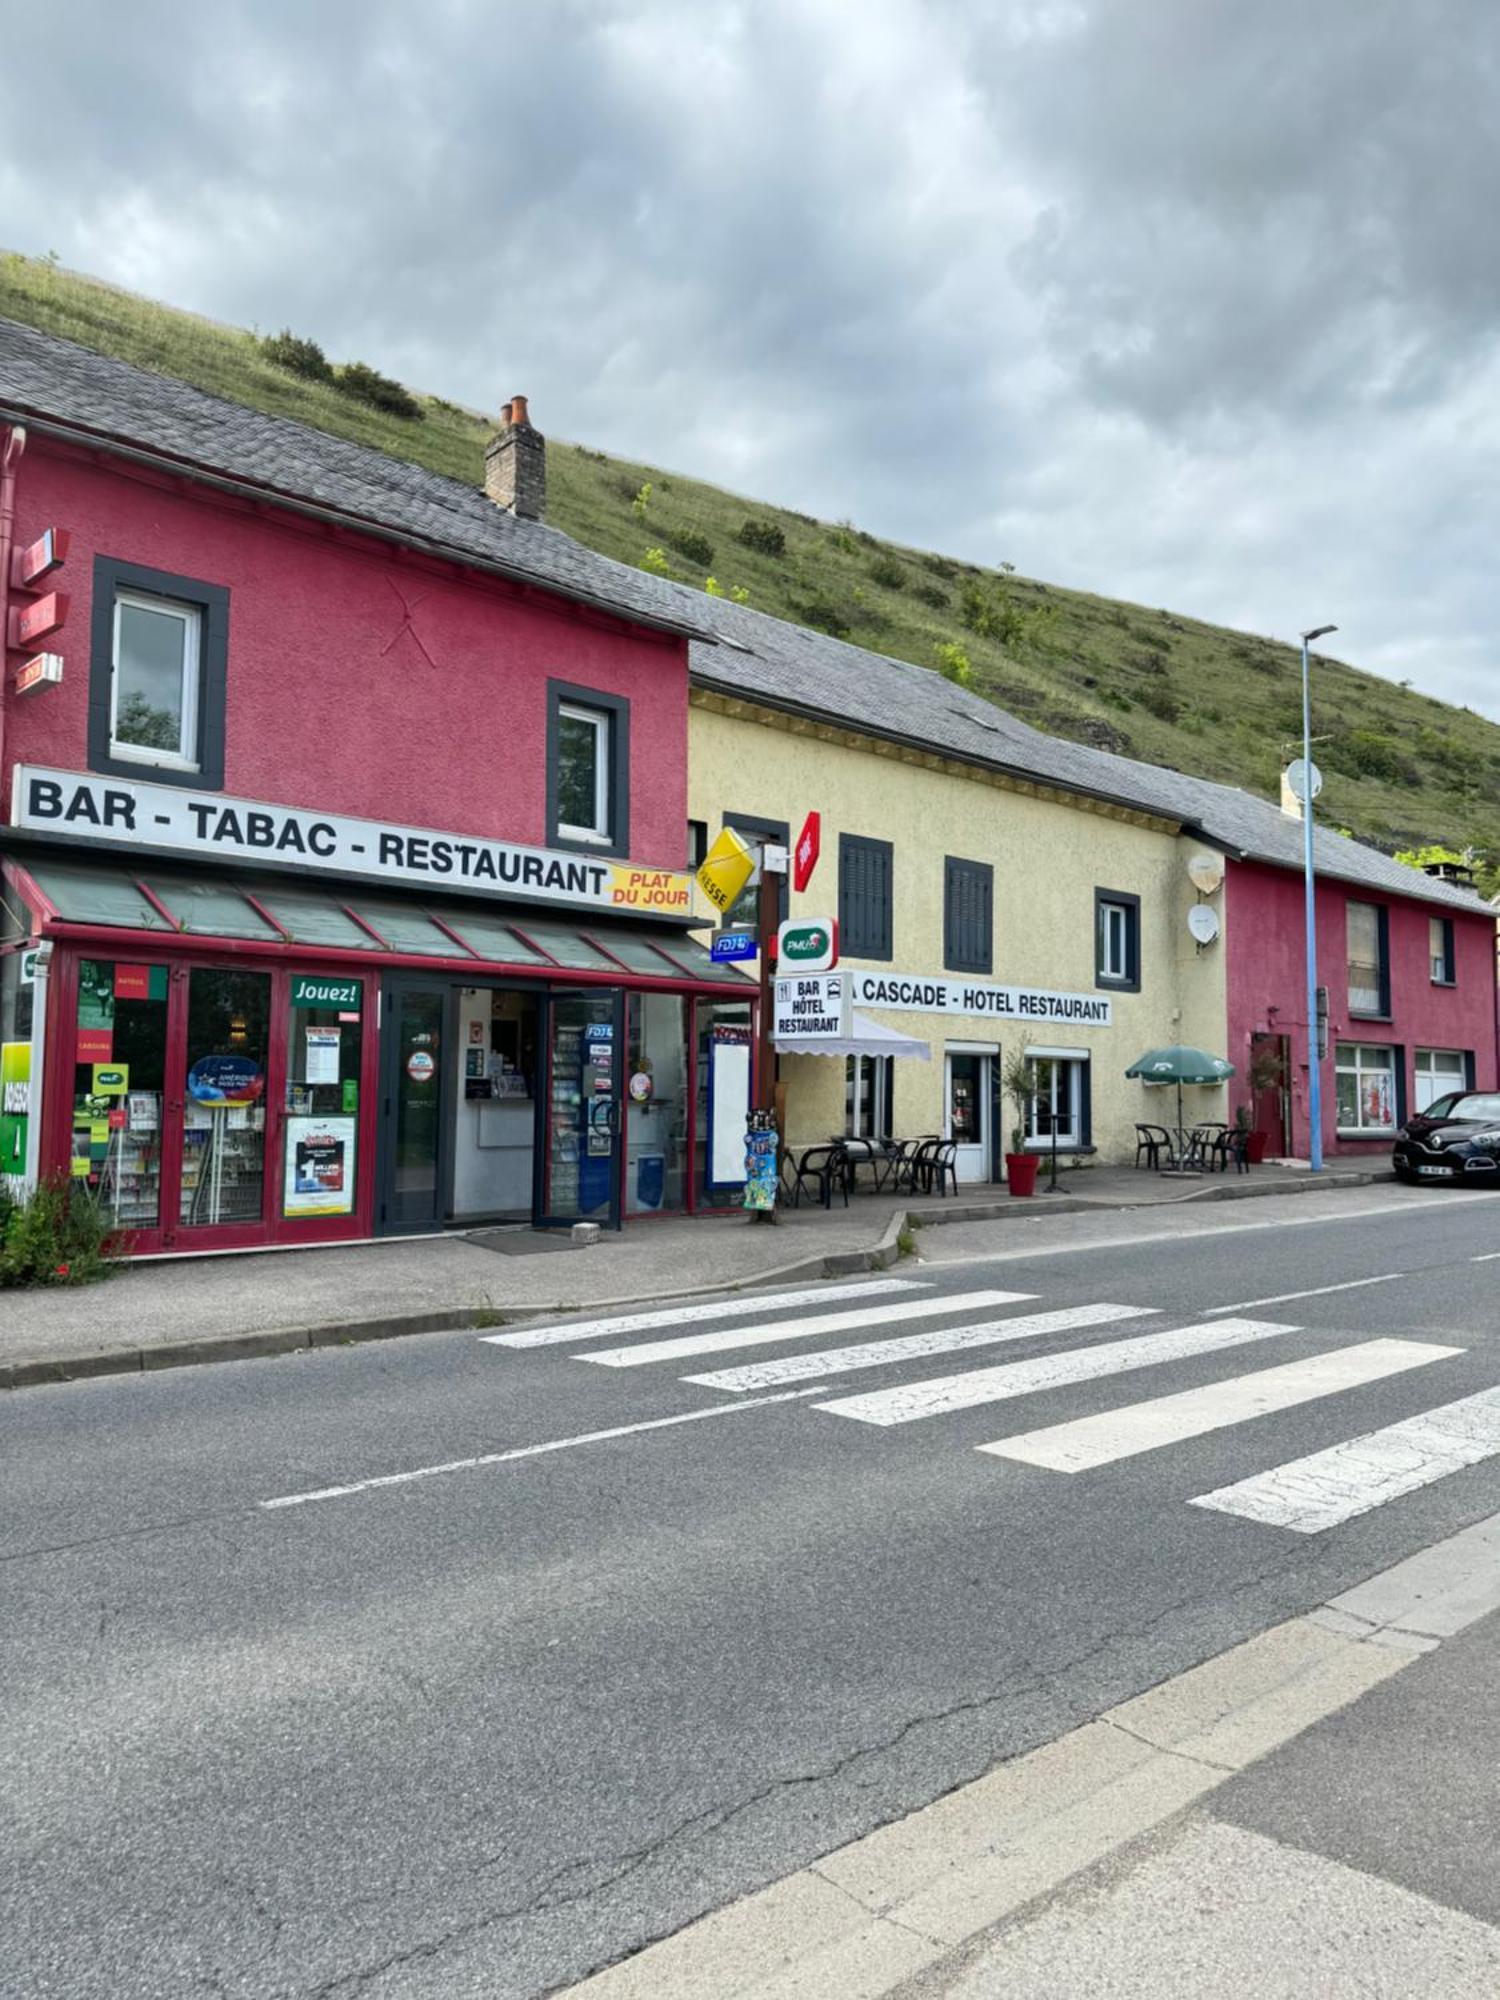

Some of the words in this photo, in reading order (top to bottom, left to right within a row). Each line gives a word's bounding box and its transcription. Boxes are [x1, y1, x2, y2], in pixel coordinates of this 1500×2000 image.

[29, 779, 136, 829] BAR
[188, 803, 337, 856] TABAC
[379, 833, 607, 895] RESTAURANT
[630, 873, 672, 888] PLAT
[613, 888, 638, 903] DU
[643, 889, 689, 905] JOUR
[717, 938, 737, 951] FDJ
[787, 940, 808, 952] PMU
[296, 982, 356, 1002] Jouez!
[797, 981, 820, 996] BAR
[792, 996, 825, 1015] HÔTEL
[863, 979, 946, 1006] CASCADE
[963, 989, 1014, 1012] HOTEL
[1019, 994, 1109, 1020] RESTAURANT
[778, 1017, 839, 1033] RESTAURANT
